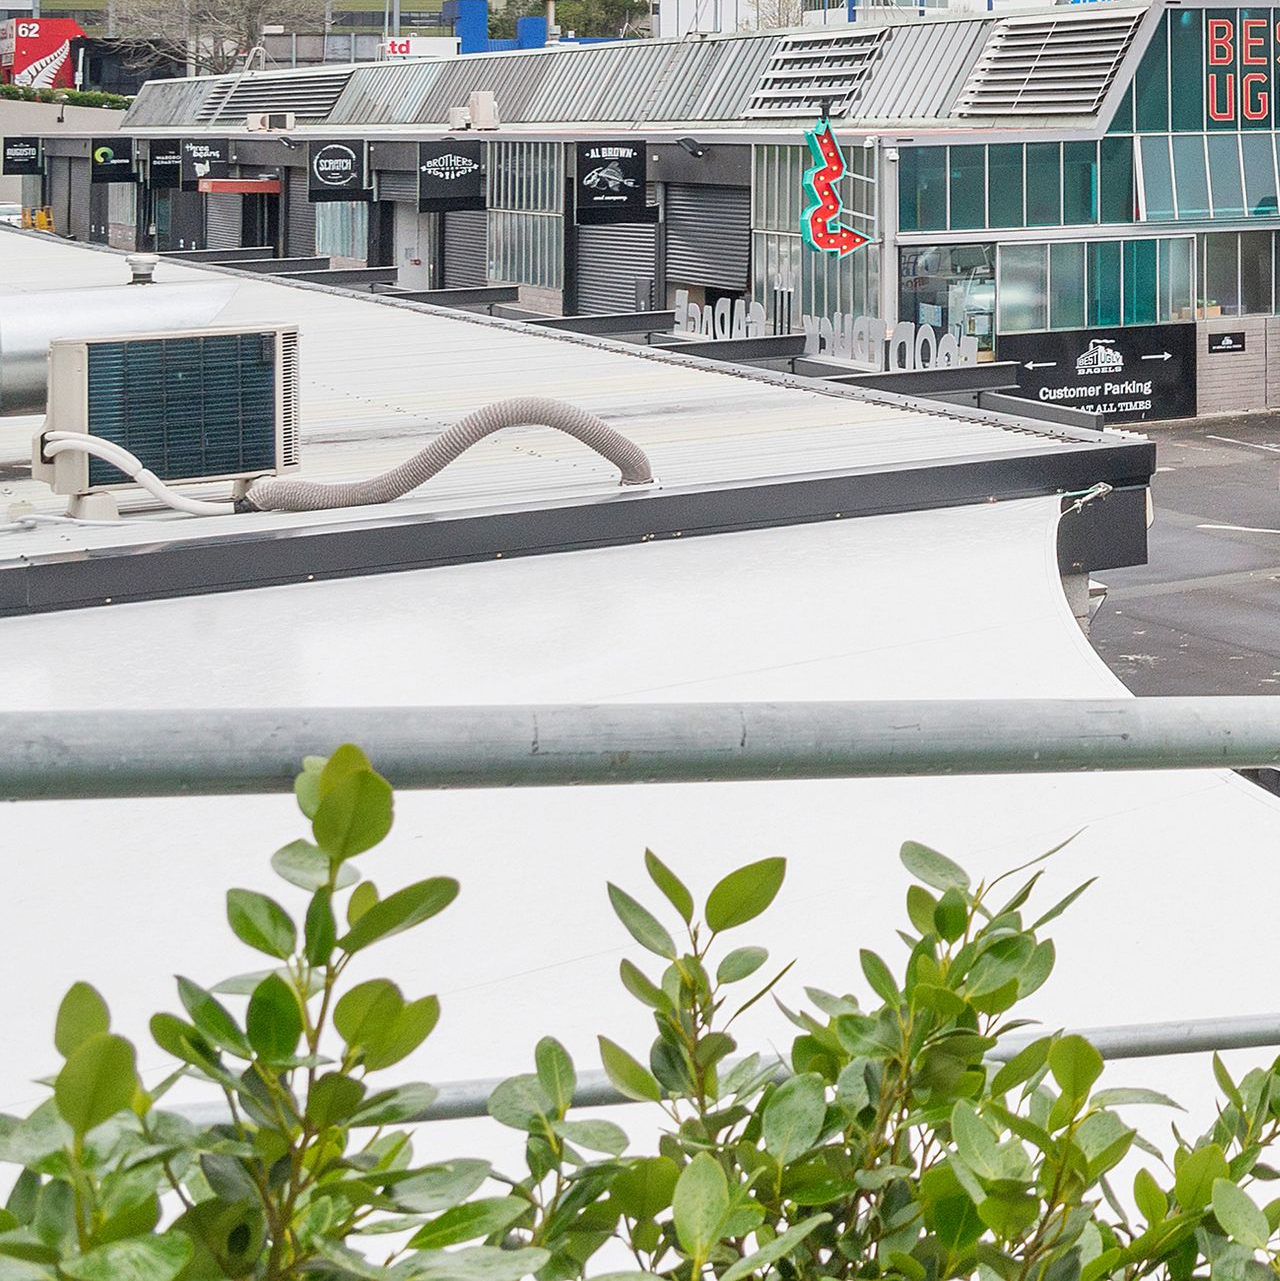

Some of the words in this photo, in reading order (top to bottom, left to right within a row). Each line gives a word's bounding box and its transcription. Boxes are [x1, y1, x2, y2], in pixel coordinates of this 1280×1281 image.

[18, 23, 39, 37] 62
[386, 40, 410, 54] td
[185, 143, 209, 151] three
[193, 149, 220, 158] beans
[590, 148, 600, 158] AL
[602, 147, 633, 158] BROWN
[426, 154, 473, 168] BROTHERS
[1077, 366, 1122, 375] BAGELS
[1039, 385, 1102, 401] Customer
[1104, 380, 1153, 395] Parking
[1095, 403, 1117, 414] ALL
[1118, 400, 1152, 412] TIMES
